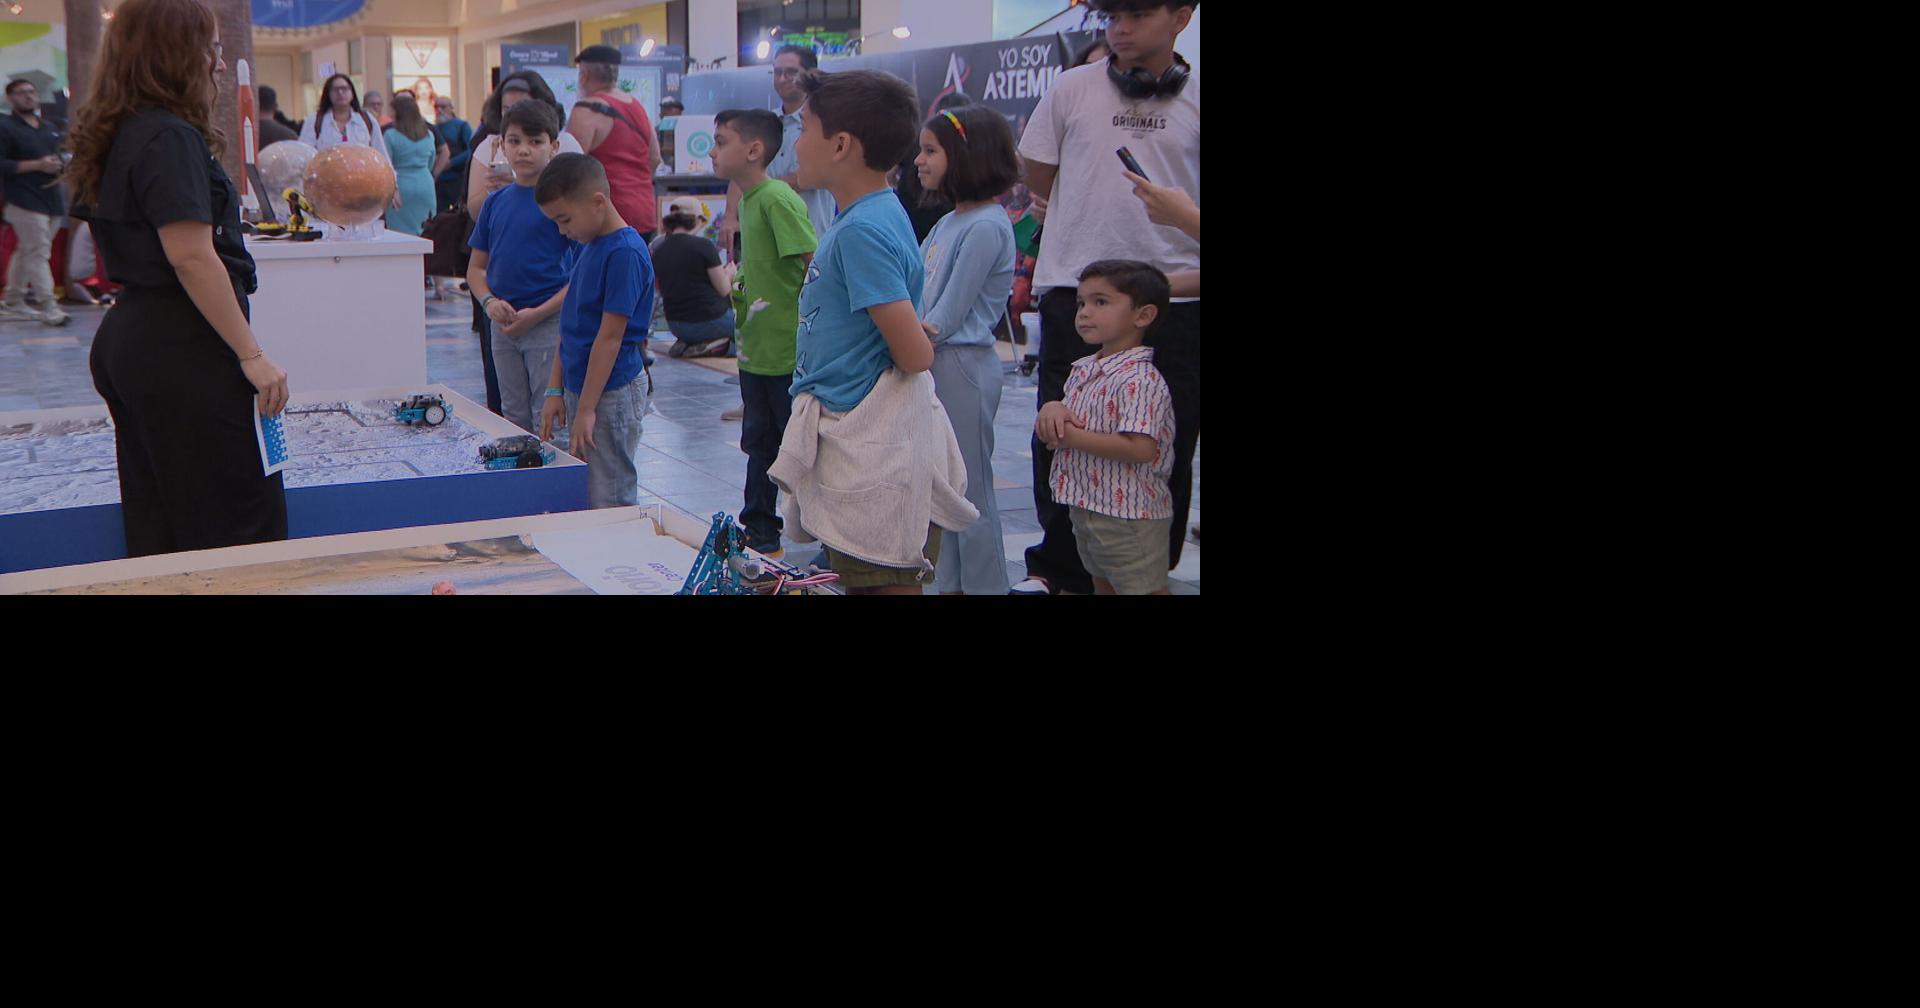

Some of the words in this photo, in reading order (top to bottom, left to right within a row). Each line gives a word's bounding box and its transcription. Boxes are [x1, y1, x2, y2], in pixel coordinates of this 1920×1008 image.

[998, 47, 1018, 69] YO
[1021, 43, 1051, 67] SOY
[983, 64, 1063, 101] ARTEMI
[1112, 115, 1167, 130] ORIGINALS
